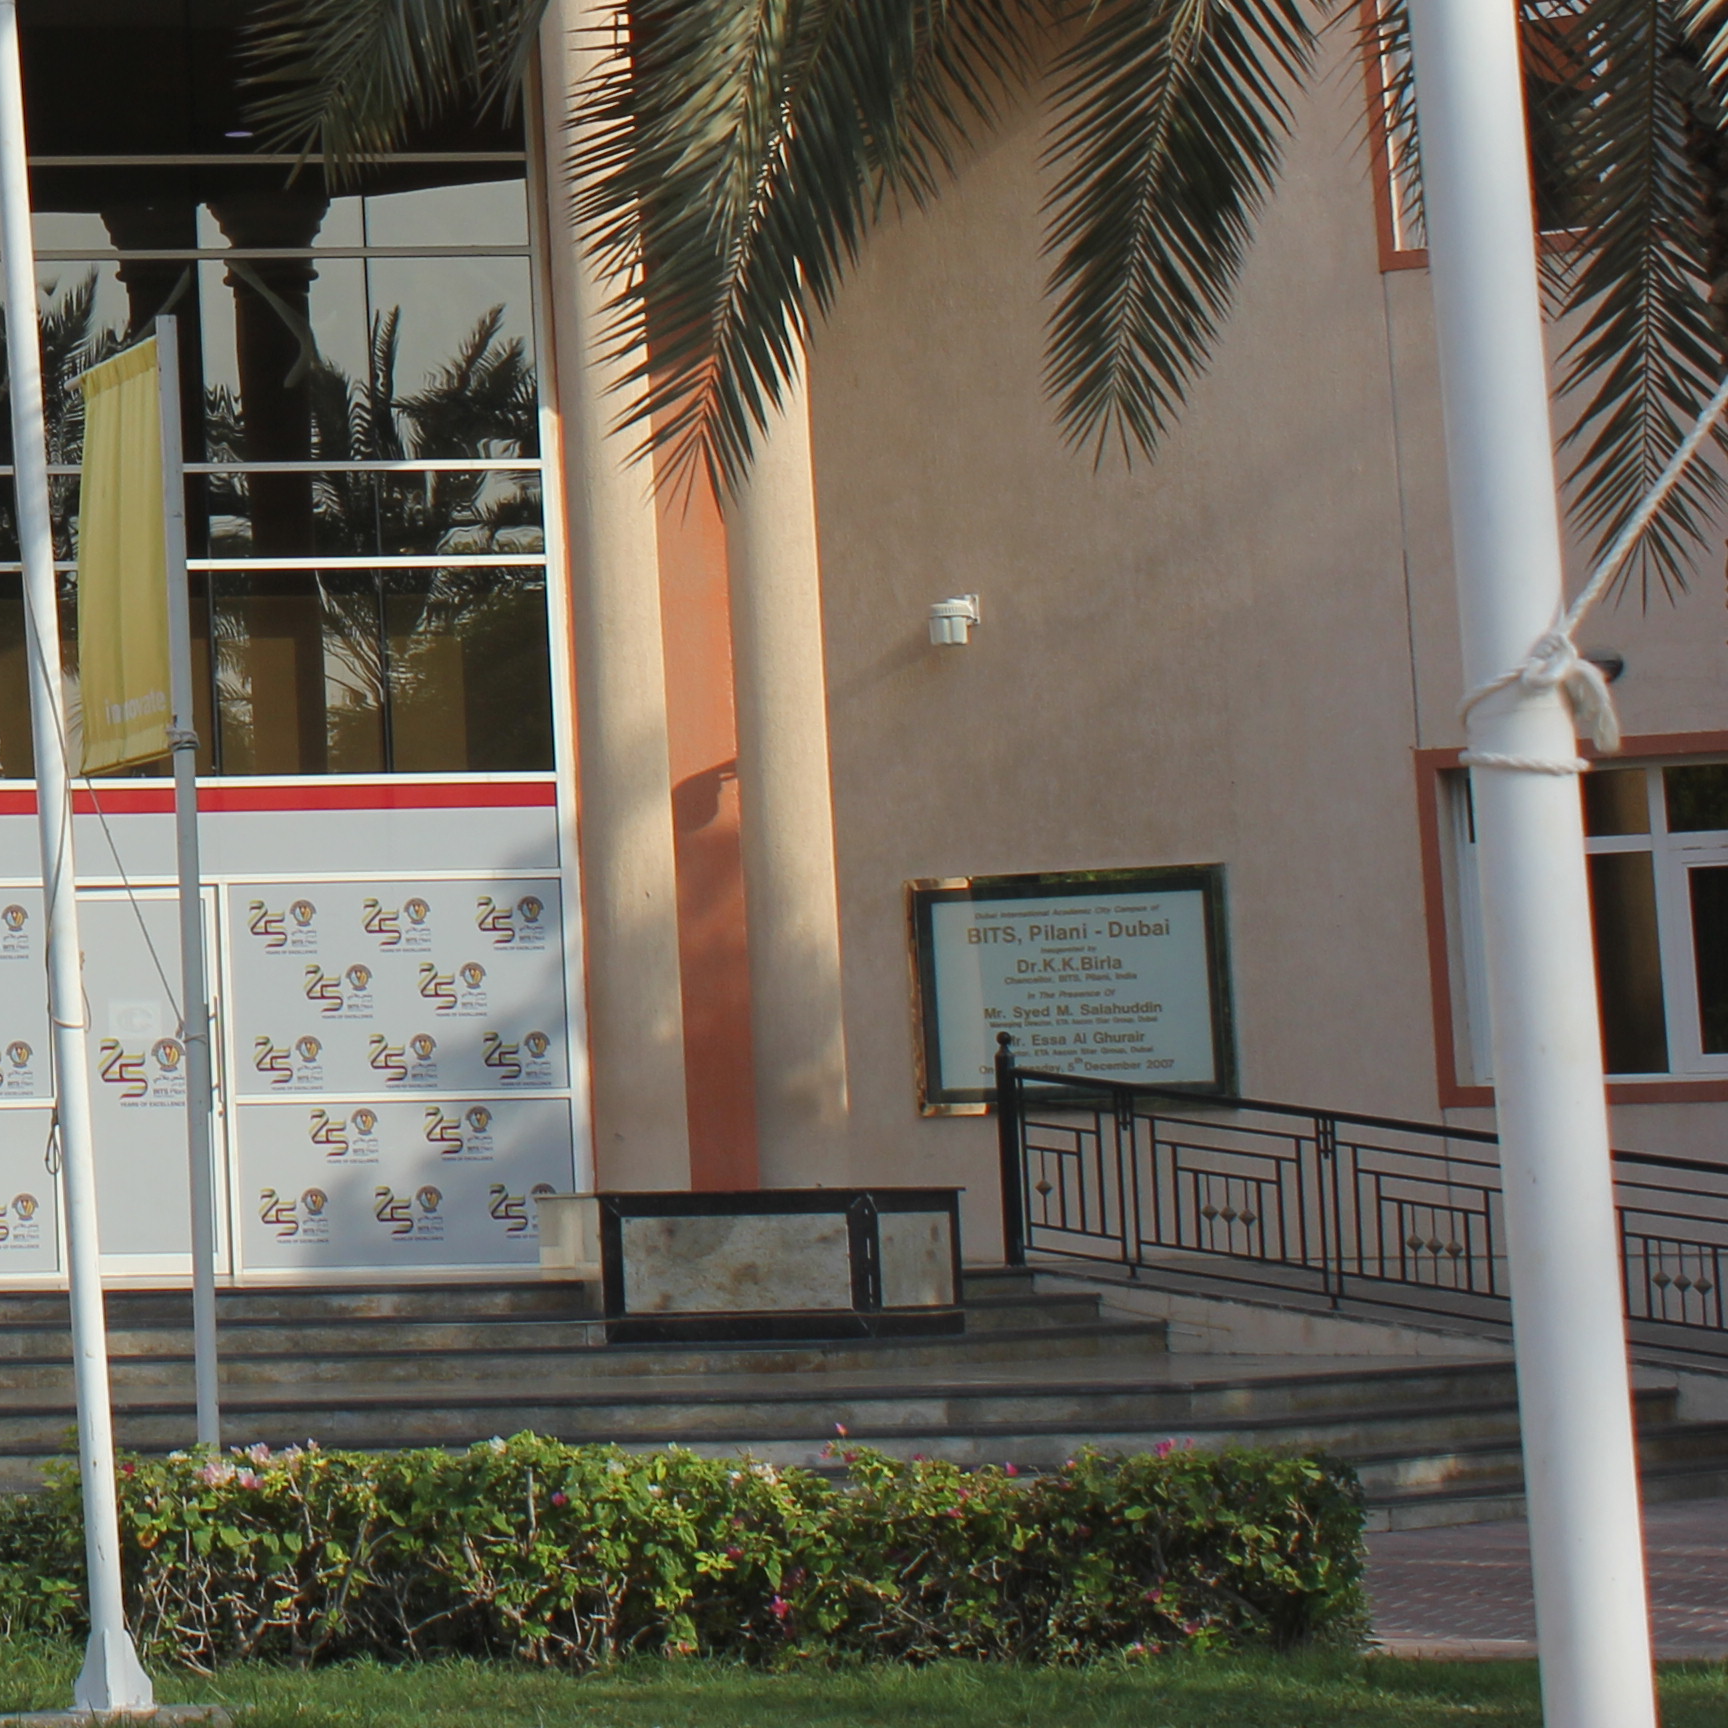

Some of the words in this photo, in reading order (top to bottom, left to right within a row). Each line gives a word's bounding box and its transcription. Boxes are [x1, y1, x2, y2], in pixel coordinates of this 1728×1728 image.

[967, 926, 1022, 946] BITS,
[1029, 922, 1087, 942] Pilani
[1108, 918, 1170, 938] Dubai
[1031, 1033, 1066, 1047] Essa
